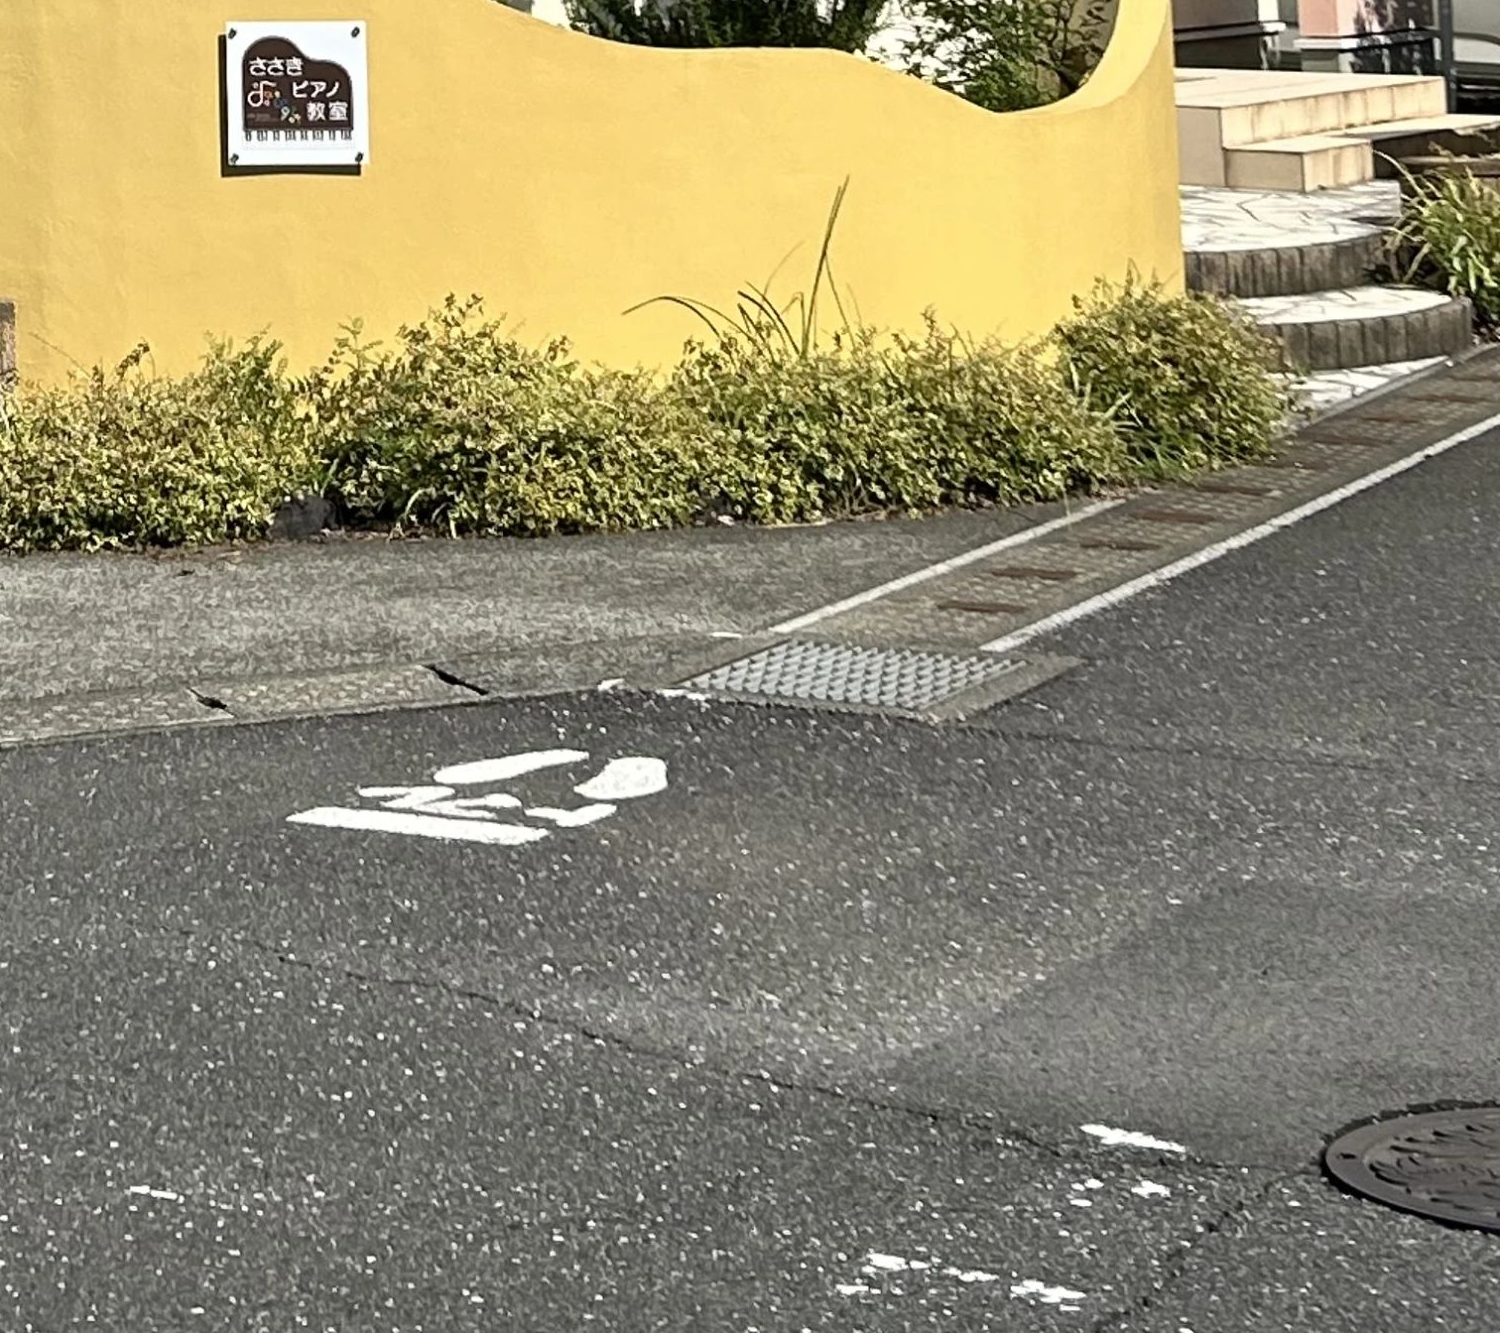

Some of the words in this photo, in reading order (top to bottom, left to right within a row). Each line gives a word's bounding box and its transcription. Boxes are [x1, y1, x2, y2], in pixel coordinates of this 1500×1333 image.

[249, 56, 303, 76] ささき
[292, 80, 340, 98] ピアノ
[306, 101, 348, 121] 教室
